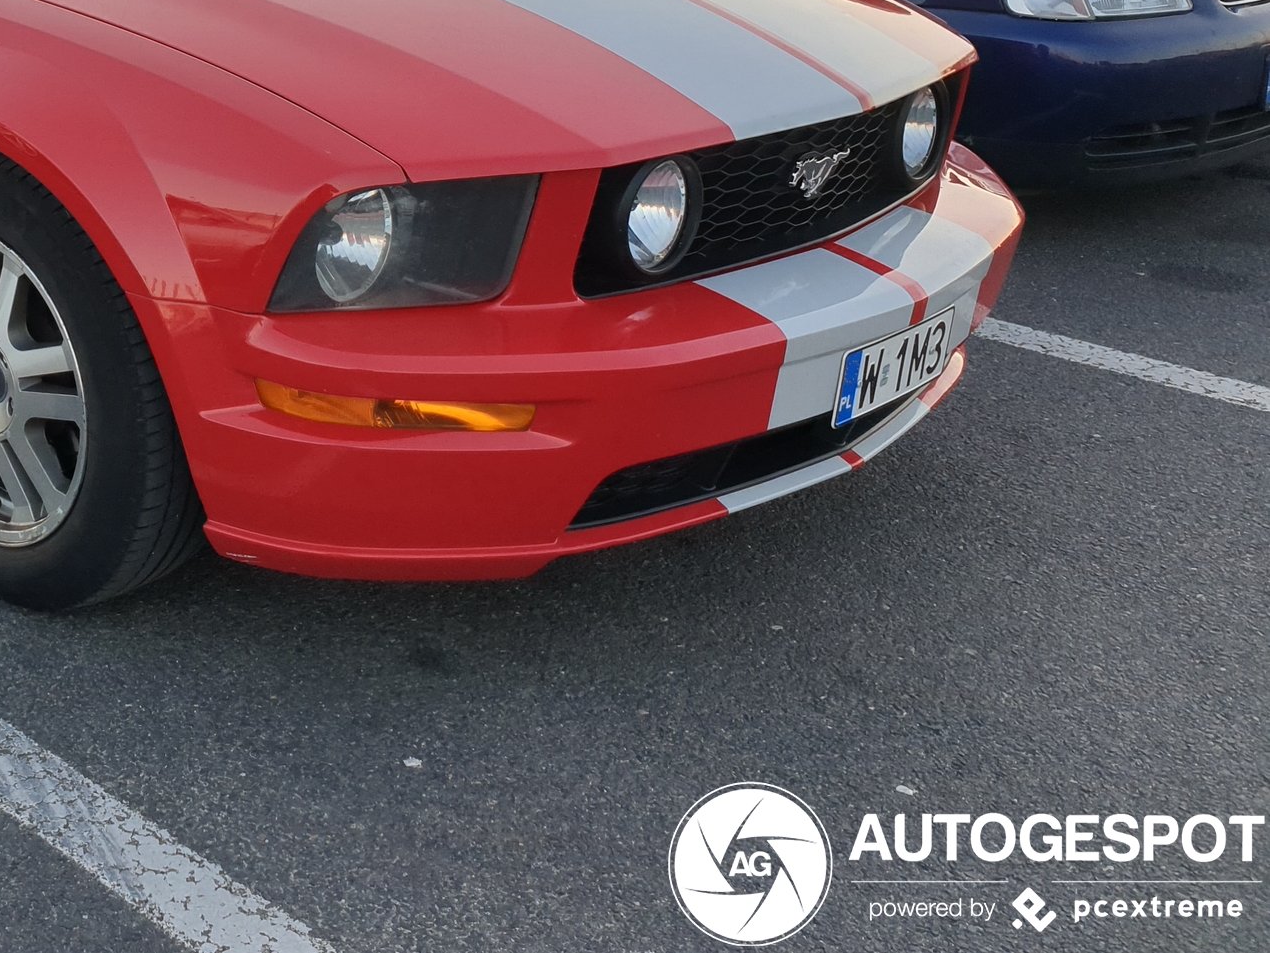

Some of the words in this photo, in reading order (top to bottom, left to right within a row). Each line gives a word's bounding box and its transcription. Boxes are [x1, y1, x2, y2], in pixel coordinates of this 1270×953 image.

[838, 394, 852, 413] PL
[857, 347, 885, 410] W
[894, 320, 946, 393] 1M3
